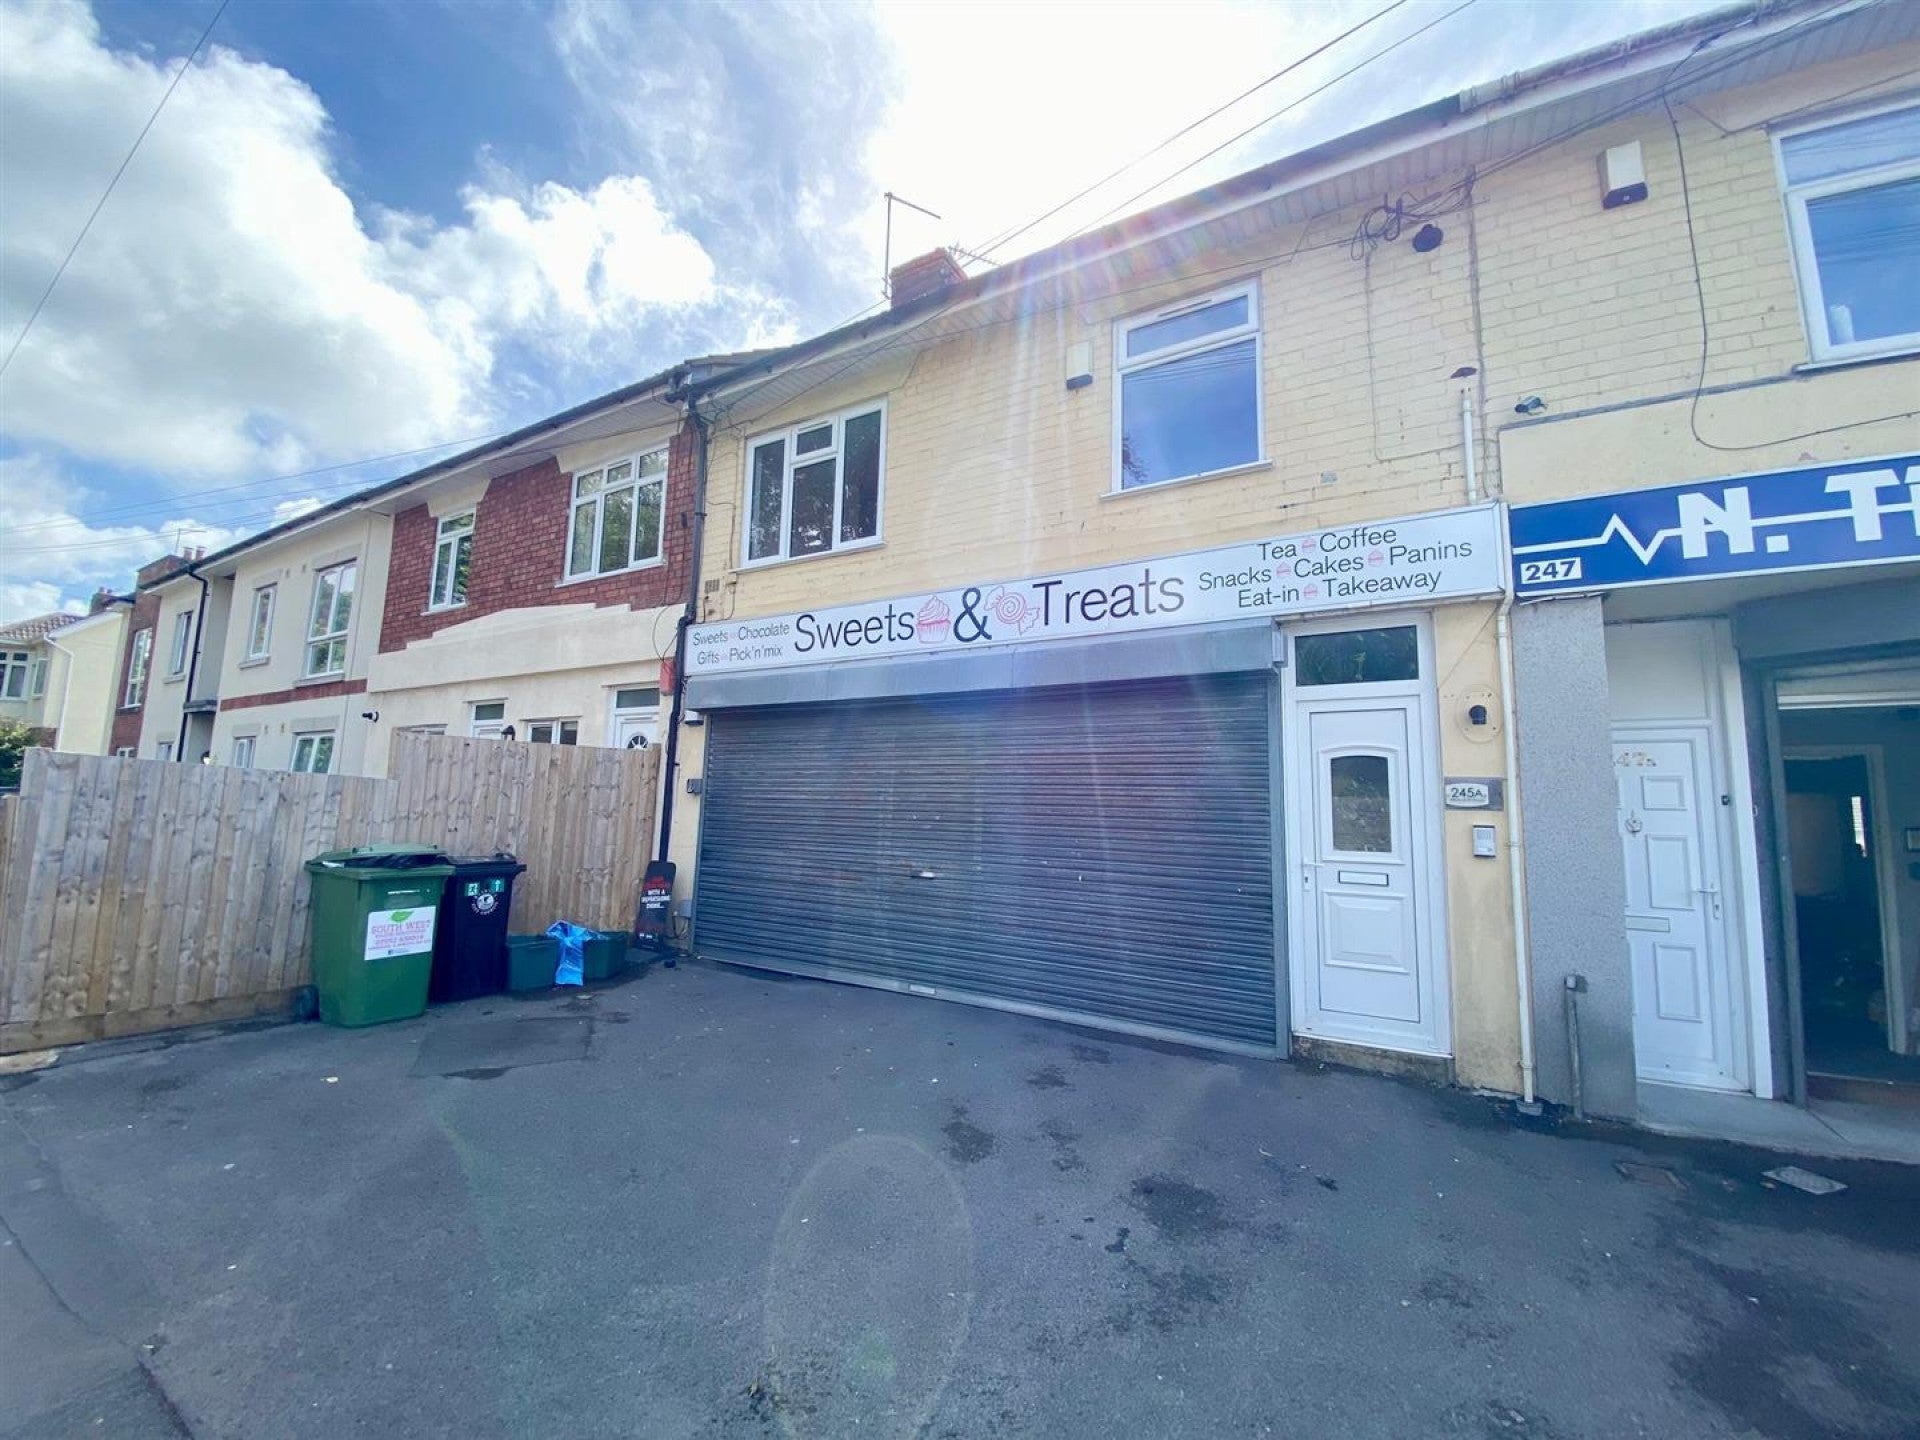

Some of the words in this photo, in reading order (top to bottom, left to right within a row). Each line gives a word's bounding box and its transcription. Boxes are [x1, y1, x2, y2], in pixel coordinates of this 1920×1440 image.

[1257, 541, 1298, 561] Tea
[1319, 526, 1398, 553] Coffee
[1199, 567, 1272, 591] Snacks
[1293, 555, 1365, 579] Cakes
[1389, 540, 1473, 566] Panins
[1524, 560, 1577, 582] 247
[1238, 585, 1300, 608] Eat-in
[1322, 570, 1443, 598] Takeaway
[794, 603, 915, 653] Sweets
[952, 587, 993, 643] &
[1032, 567, 1185, 627] Treats
[692, 630, 729, 647] Sweets
[738, 622, 790, 641] Chocolate
[697, 649, 721, 665] Gifts
[1450, 787, 1484, 798] 245A
